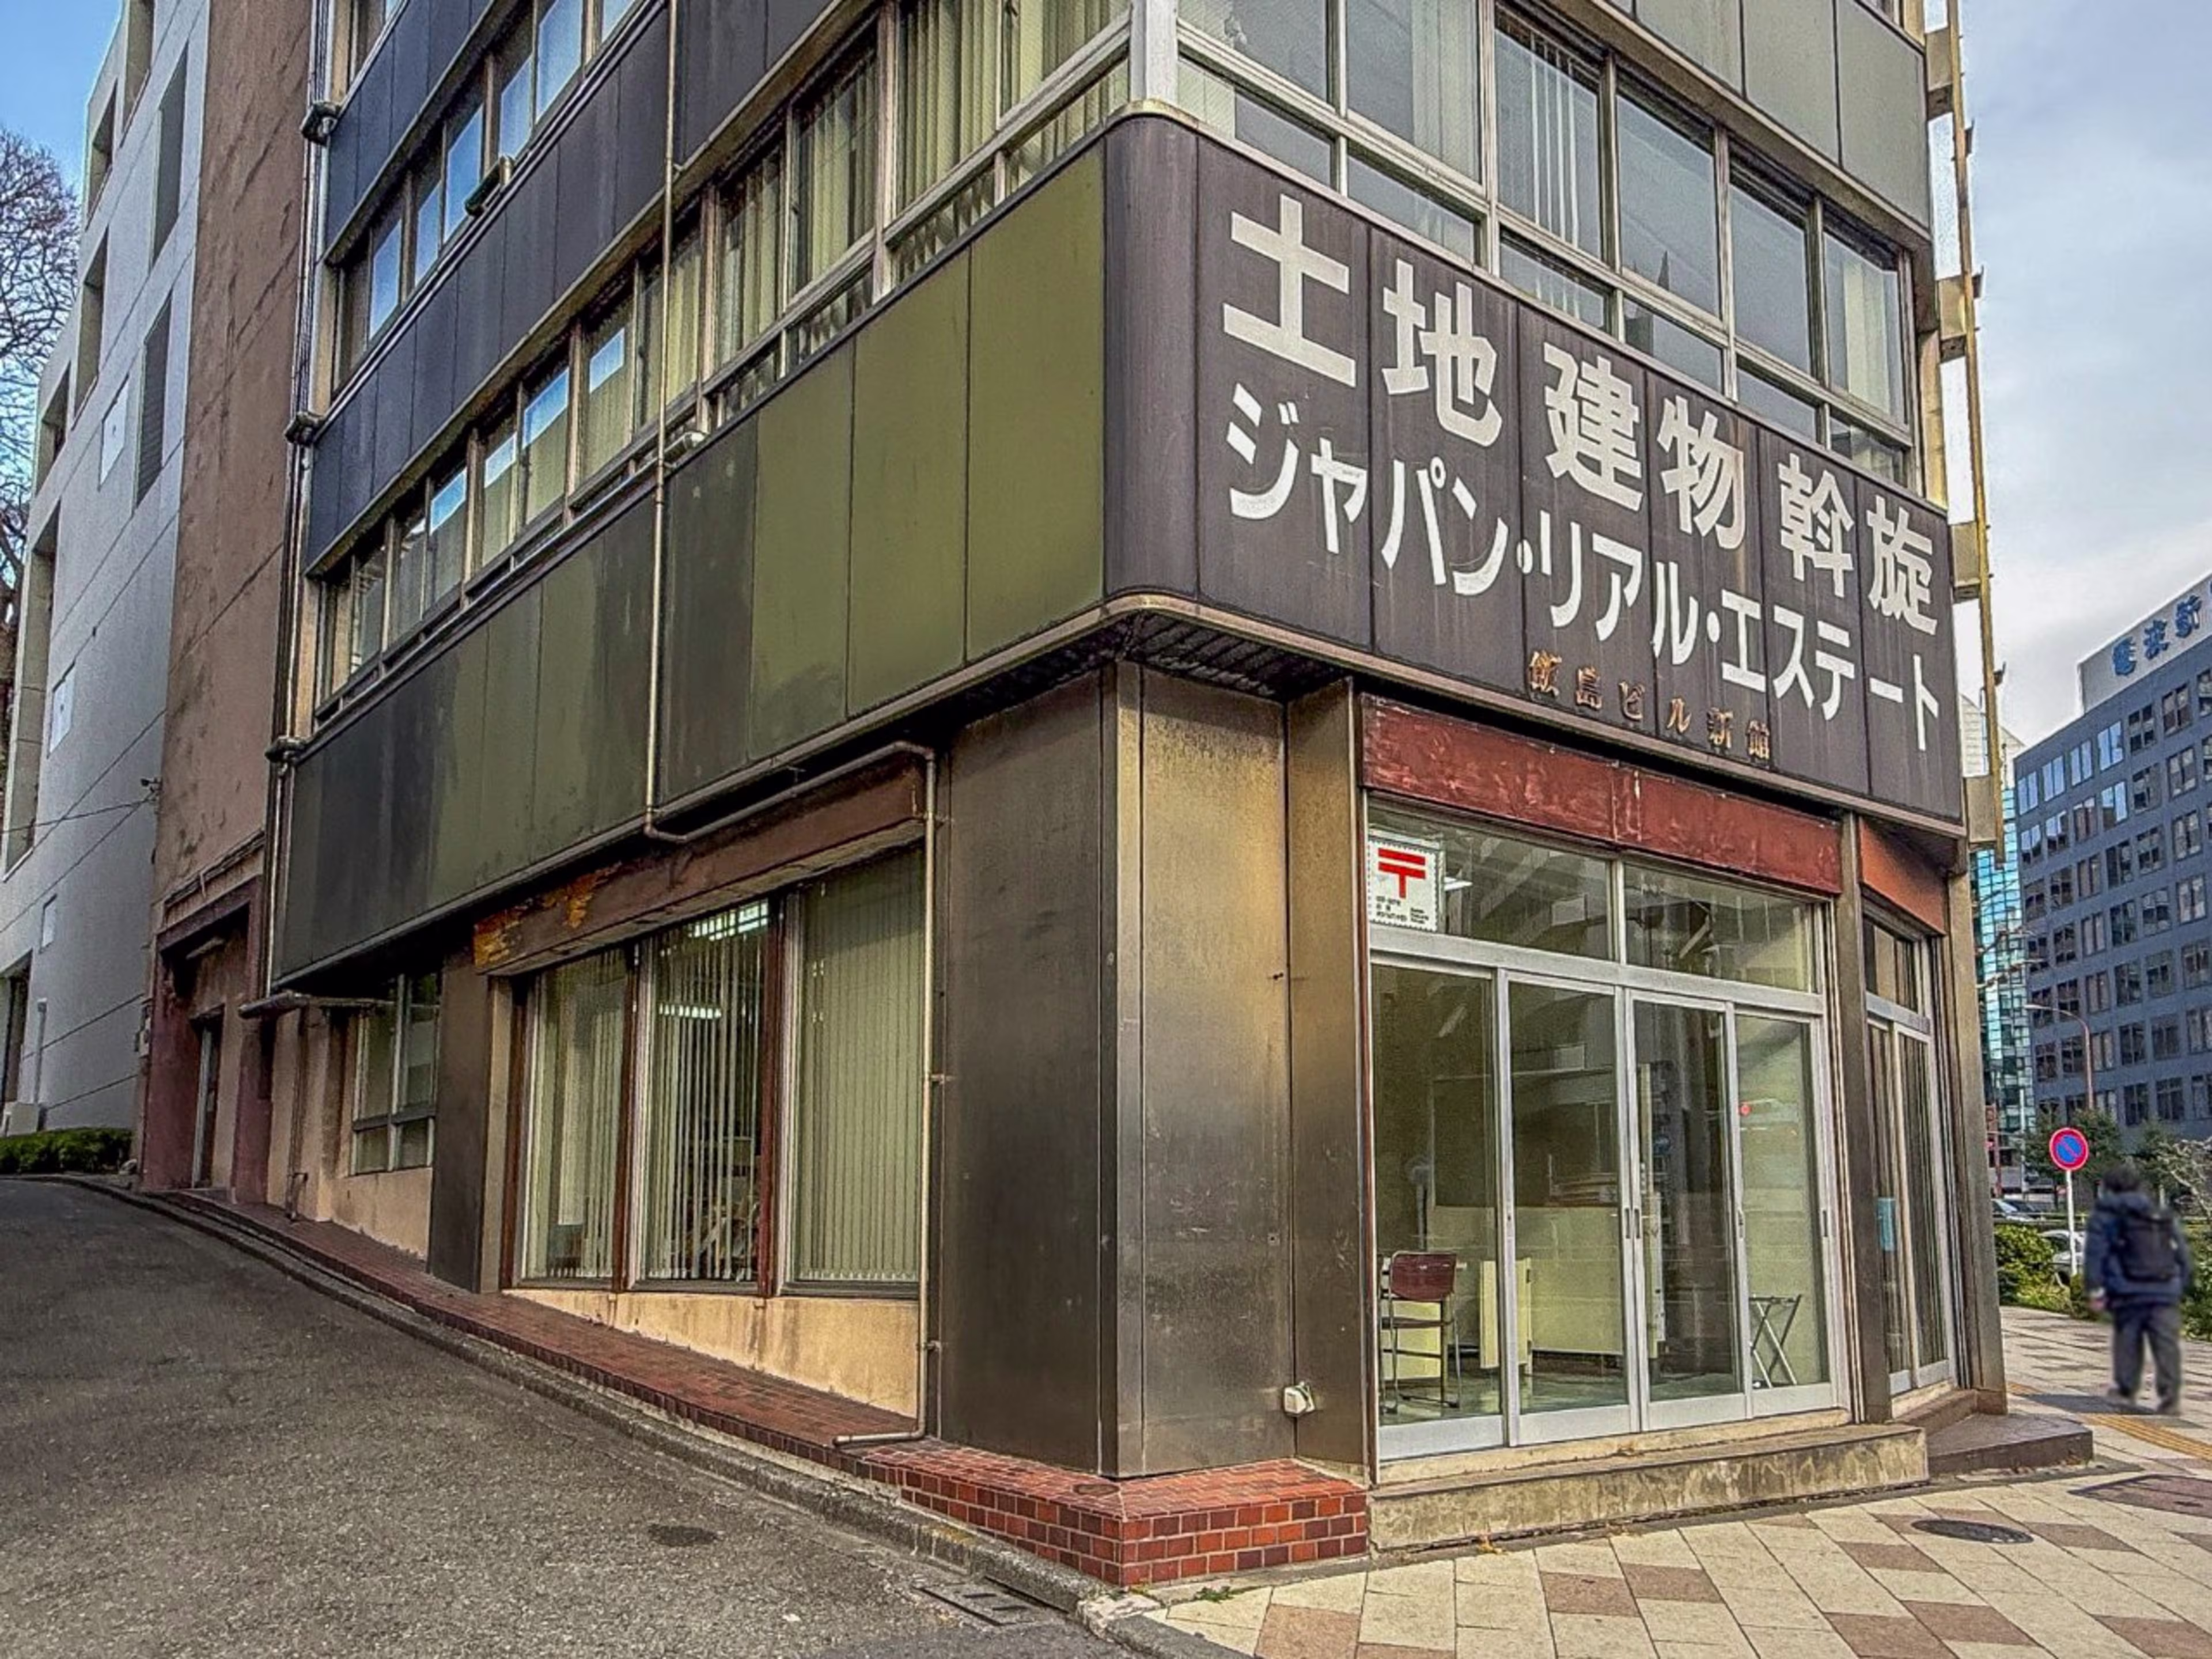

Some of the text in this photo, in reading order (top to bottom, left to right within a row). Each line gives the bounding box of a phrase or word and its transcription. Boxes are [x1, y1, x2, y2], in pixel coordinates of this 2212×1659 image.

[1223, 194, 1938, 635] 土地建物斡旋
